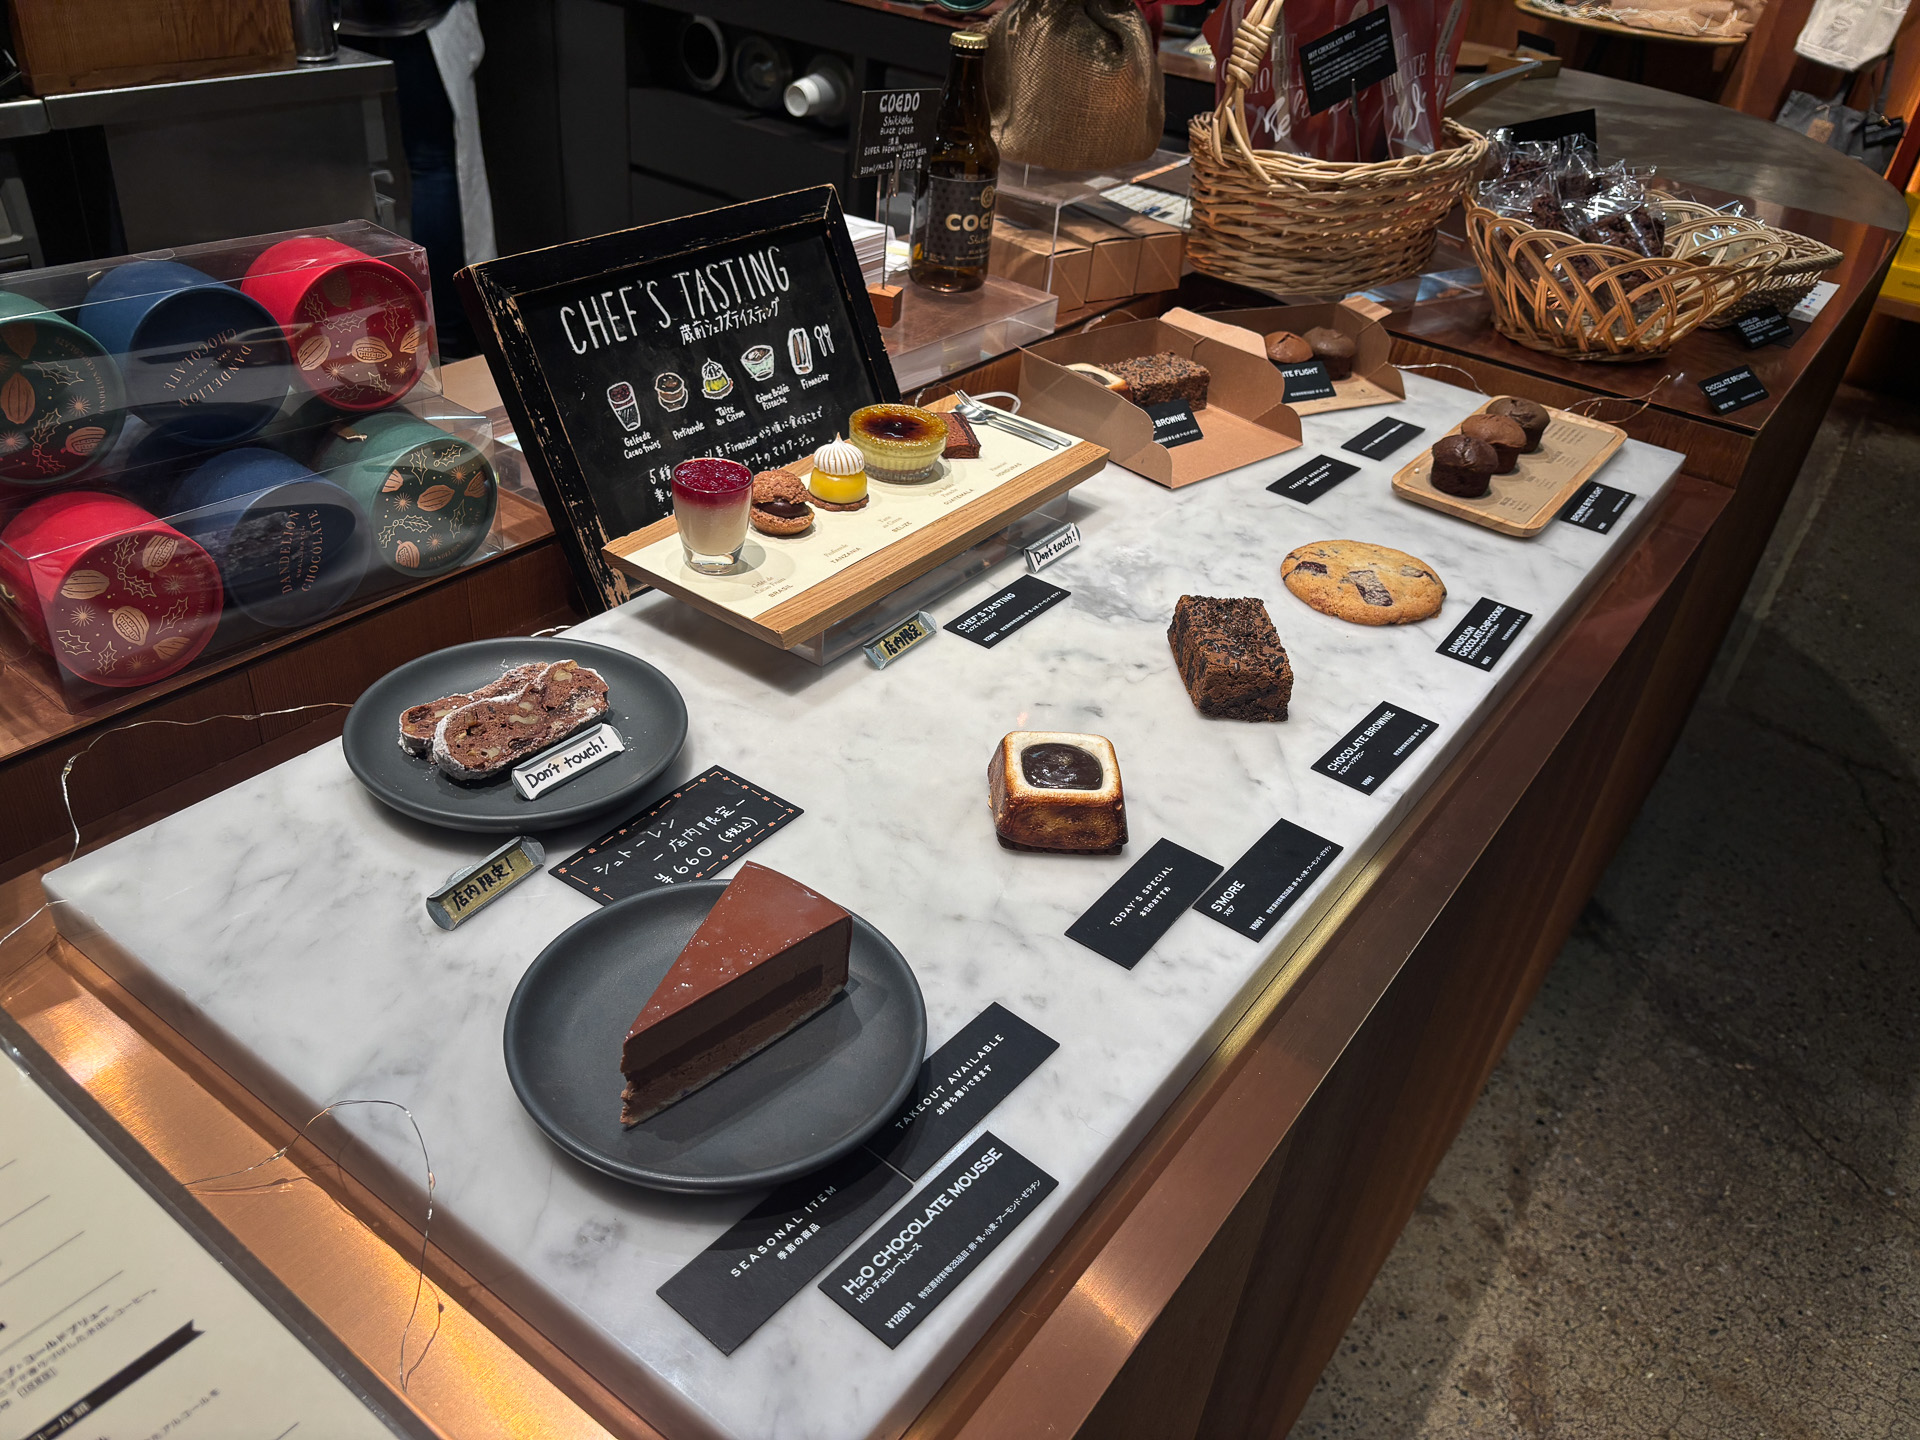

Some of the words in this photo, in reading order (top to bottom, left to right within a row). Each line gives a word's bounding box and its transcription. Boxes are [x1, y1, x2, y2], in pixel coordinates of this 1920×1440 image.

[879, 92, 920, 113] COEDO
[560, 279, 671, 355] CHEF'S
[672, 246, 790, 320] TASTING
[164, 328, 237, 392] CHOCOLATE
[179, 344, 252, 408] DANDELION
[1294, 366, 1319, 378] FLIGHT
[800, 372, 830, 391] Financier
[1155, 412, 1187, 428] BROWNIE
[279, 509, 300, 595] DANDELION
[301, 509, 323, 592] CHOCOLATE
[830, 546, 862, 564] TANZANIA
[1033, 543, 1054, 566] Don't
[1053, 530, 1077, 553] touch!
[767, 583, 794, 598] BRASIL
[956, 610, 987, 631] CHEF'S
[982, 592, 1017, 614] TASTING
[1447, 625, 1477, 654] DANDELION
[1457, 629, 1486, 657] CHOCOLATE
[1326, 735, 1369, 772] CHOCOLATE
[1363, 710, 1396, 738] BROWNIE
[524, 763, 561, 789] Don't
[563, 735, 609, 769] touch!
[592, 818, 675, 876] シュトーレン
[653, 845, 713, 885] ¥660
[1109, 894, 1144, 928] TODAY'S
[1142, 866, 1174, 896] SPECIAL
[1139, 886, 1172, 918] 本日のおすすめ
[1210, 880, 1246, 913] S'MORE
[1223, 904, 1236, 917] スモア
[895, 1085, 945, 1130] TAKEOUT
[947, 1033, 1005, 1085] AVAILABLE
[936, 1063, 992, 1116] お持ち帰りできます
[872, 1193, 954, 1268] CHOCOLATE
[946, 1146, 1004, 1199] MOUSSE
[730, 1216, 804, 1278] SEASONAL
[804, 1185, 837, 1214] ITEM
[776, 1222, 821, 1260] 季節の商品
[873, 1241, 923, 1290] チョコレートムース
